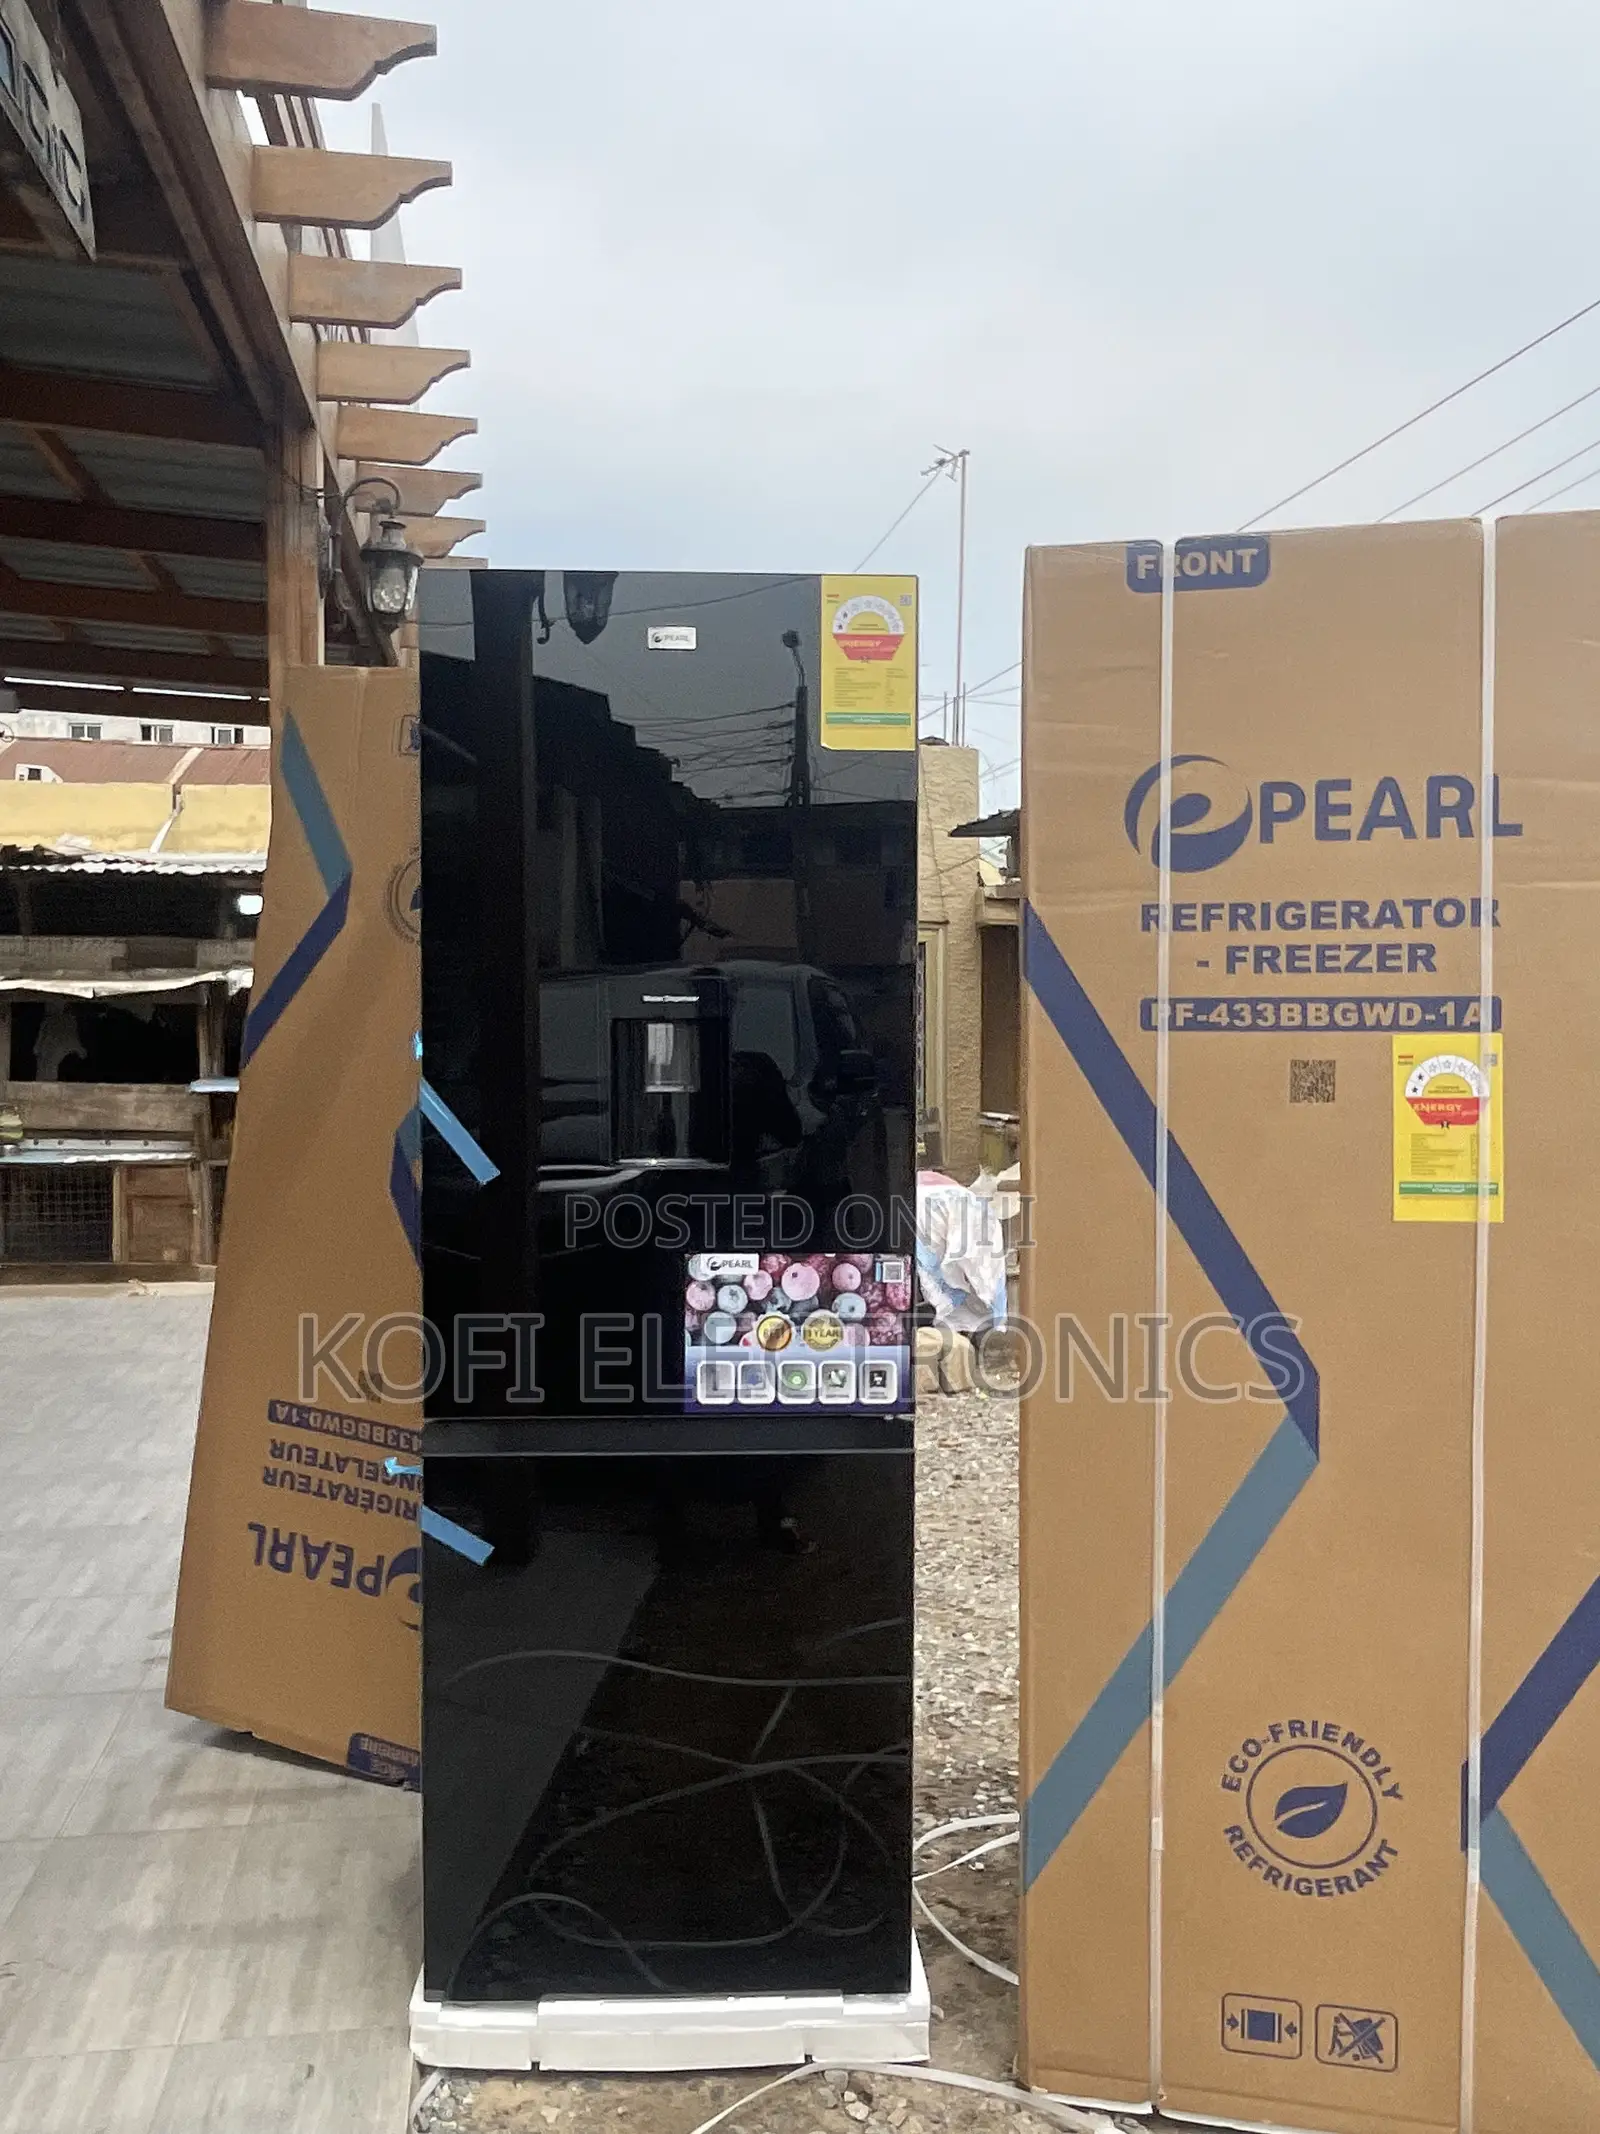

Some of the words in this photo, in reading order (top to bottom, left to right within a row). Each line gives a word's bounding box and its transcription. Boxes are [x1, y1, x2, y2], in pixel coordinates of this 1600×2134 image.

[1259, 773, 1523, 844] PEARL
[1141, 898, 1501, 932] REFRIGERATOR
[1226, 943, 1437, 974] FREEZER
[721, 1259, 753, 1268] PEARL
[248, 1522, 386, 1599] PEARL
[1220, 1718, 1404, 1801] ECO-FRIENDLY
[1223, 1824, 1400, 1898] REFRIGERANT
